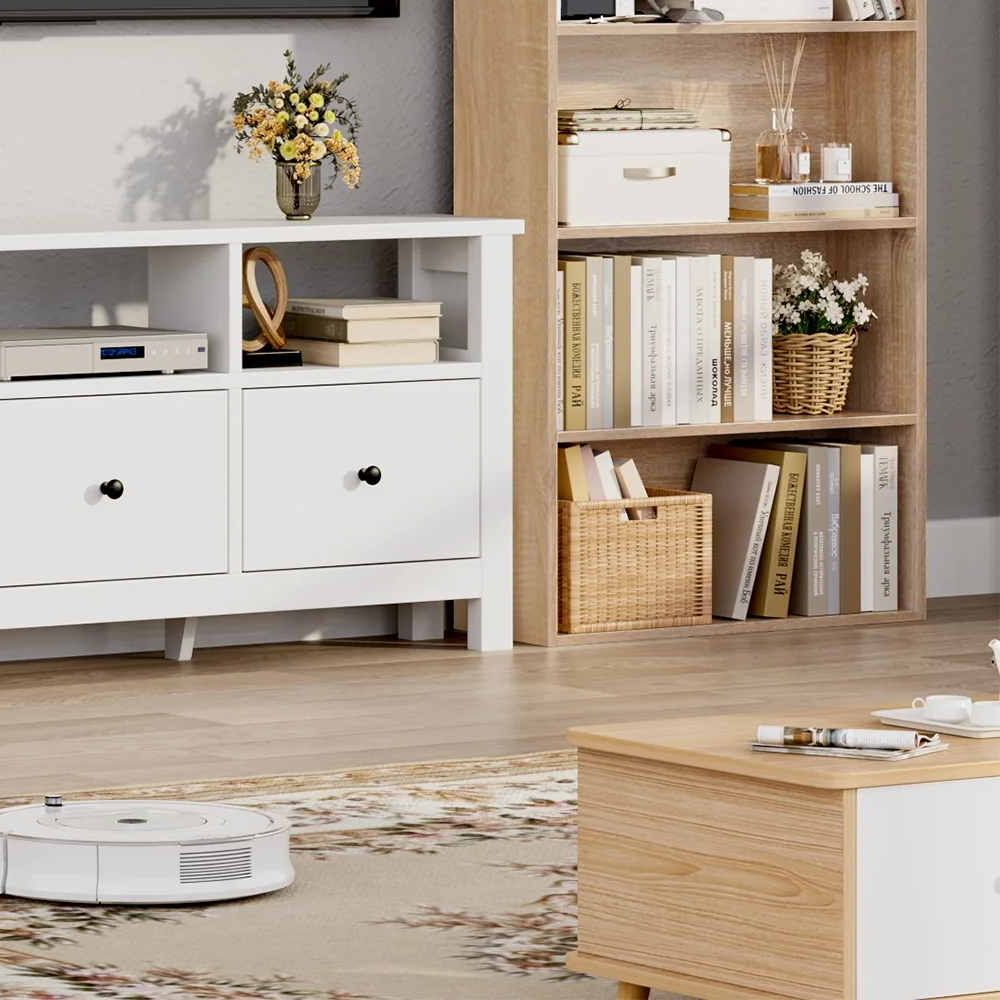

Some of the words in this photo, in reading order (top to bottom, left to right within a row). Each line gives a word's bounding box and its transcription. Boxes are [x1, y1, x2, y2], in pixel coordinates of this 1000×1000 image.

[793, 186, 826, 196] FASHION
[828, 185, 838, 195] OF
[841, 185, 871, 194] SCHOOL
[873, 184, 887, 193] THE
[572, 283, 582, 341] БОЖЕСТВЕННАЯ
[572, 344, 581, 379] КОМЕДИЯ
[648, 324, 658, 389] Триумфальная
[711, 359, 719, 407] ШОКОЛАД
[572, 385, 584, 407] РАЙ
[649, 392, 657, 412] арка
[782, 473, 799, 531] БОЖЕСТВЕННАЯ
[778, 532, 791, 567] КОМЕДИЯ
[882, 512, 892, 574] Триумфальная
[774, 573, 788, 595] РАЙ
[882, 578, 890, 597] арка
[740, 589, 752, 604] Боб
